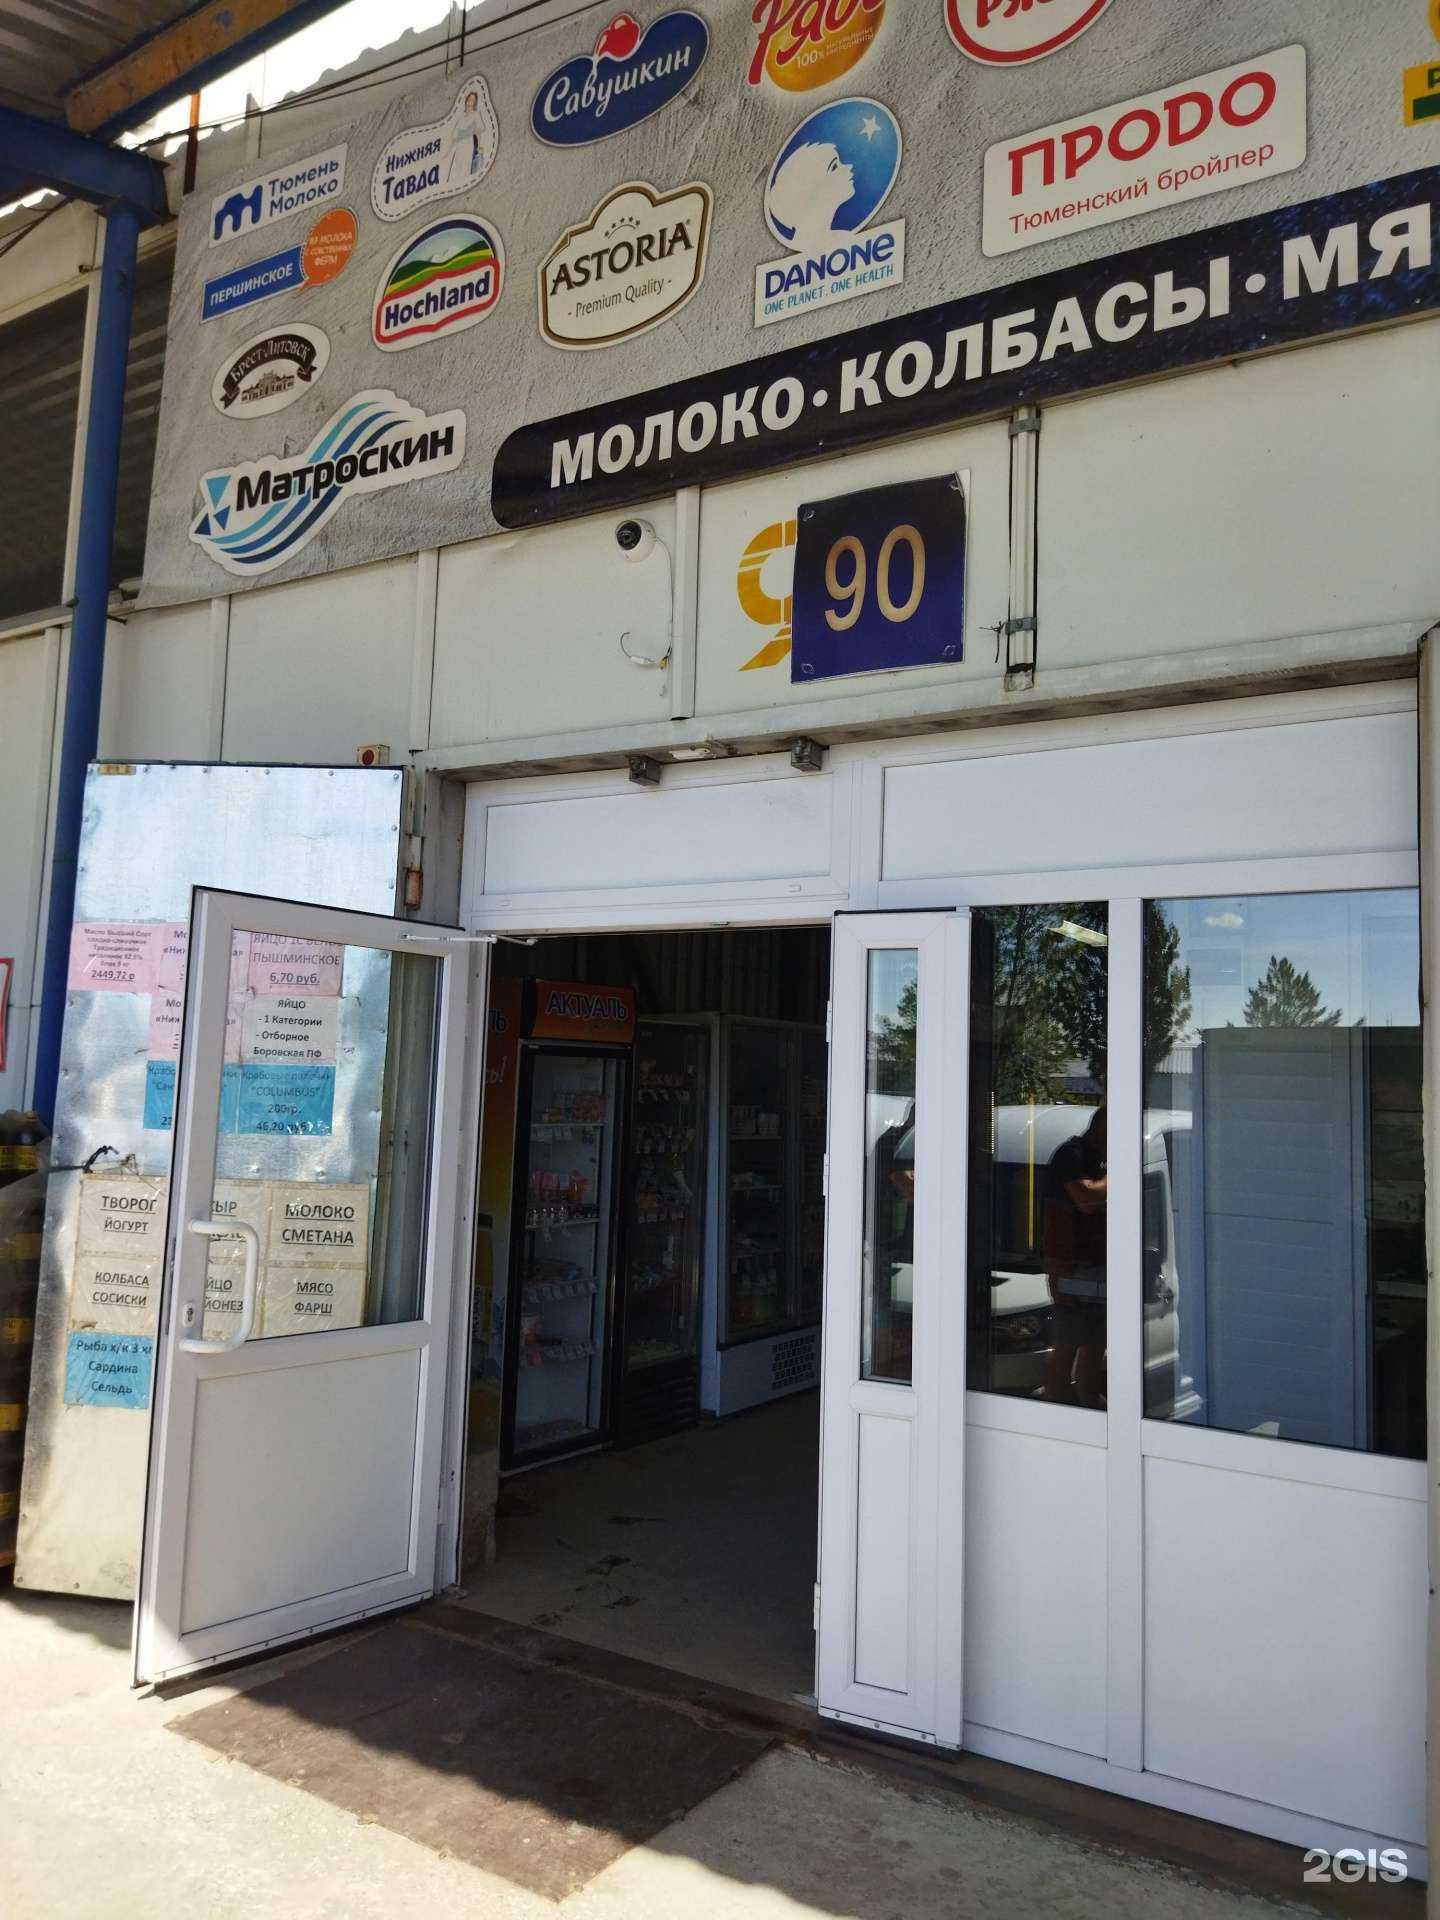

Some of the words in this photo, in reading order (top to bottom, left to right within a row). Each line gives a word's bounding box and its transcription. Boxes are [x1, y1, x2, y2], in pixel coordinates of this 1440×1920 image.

[543, 46, 690, 123] Савушкин
[385, 138, 442, 173] Нижняя
[268, 159, 339, 196] Тюмень
[382, 163, 440, 204] Тавда
[1009, 178, 1148, 235] Тюменский
[1157, 143, 1274, 193] бройлер
[269, 178, 338, 217] Молоко
[550, 220, 694, 296] ASTORIA
[209, 263, 294, 307] ПЕРШИНСКОЕ
[764, 299, 785, 315] ONE
[831, 278, 852, 294] ONE
[855, 263, 893, 287] HEALTH
[385, 272, 490, 330] Hochland
[575, 292, 622, 318] Premium
[625, 278, 664, 303] Quality
[550, 377, 804, 489] МОЛОКО
[840, 256, 1230, 413] КОЛБАСЫ
[235, 426, 454, 512] Матроскин
[825, 524, 926, 631] 90
[253, 952, 340, 966] ПЫШМИНСКОЕ
[270, 972, 293, 984] 6,70
[296, 973, 320, 985] руб.
[278, 998, 306, 1010] ЯЙЦО
[545, 990, 630, 1022] АКТУАЛЬ
[272, 1016, 323, 1027] Категории
[262, 1030, 310, 1043] Отборное
[253, 1046, 304, 1058] Боровская
[306, 1049, 322, 1058] ПФ
[102, 1195, 158, 1212] ТВОРОГ
[286, 1203, 355, 1219] МОЛОКО
[104, 1216, 149, 1232] ЙОГУРТ
[282, 1228, 354, 1244] СМЕТАНА
[95, 1271, 150, 1287] КОЛБАСА
[297, 1281, 334, 1294] МЯСО
[92, 1291, 147, 1306] СОСИСКИ
[294, 1301, 333, 1314] ФАРШ
[76, 1340, 108, 1352] Рыба
[88, 1360, 139, 1375] Сардина
[92, 1380, 133, 1395] Сельдь
